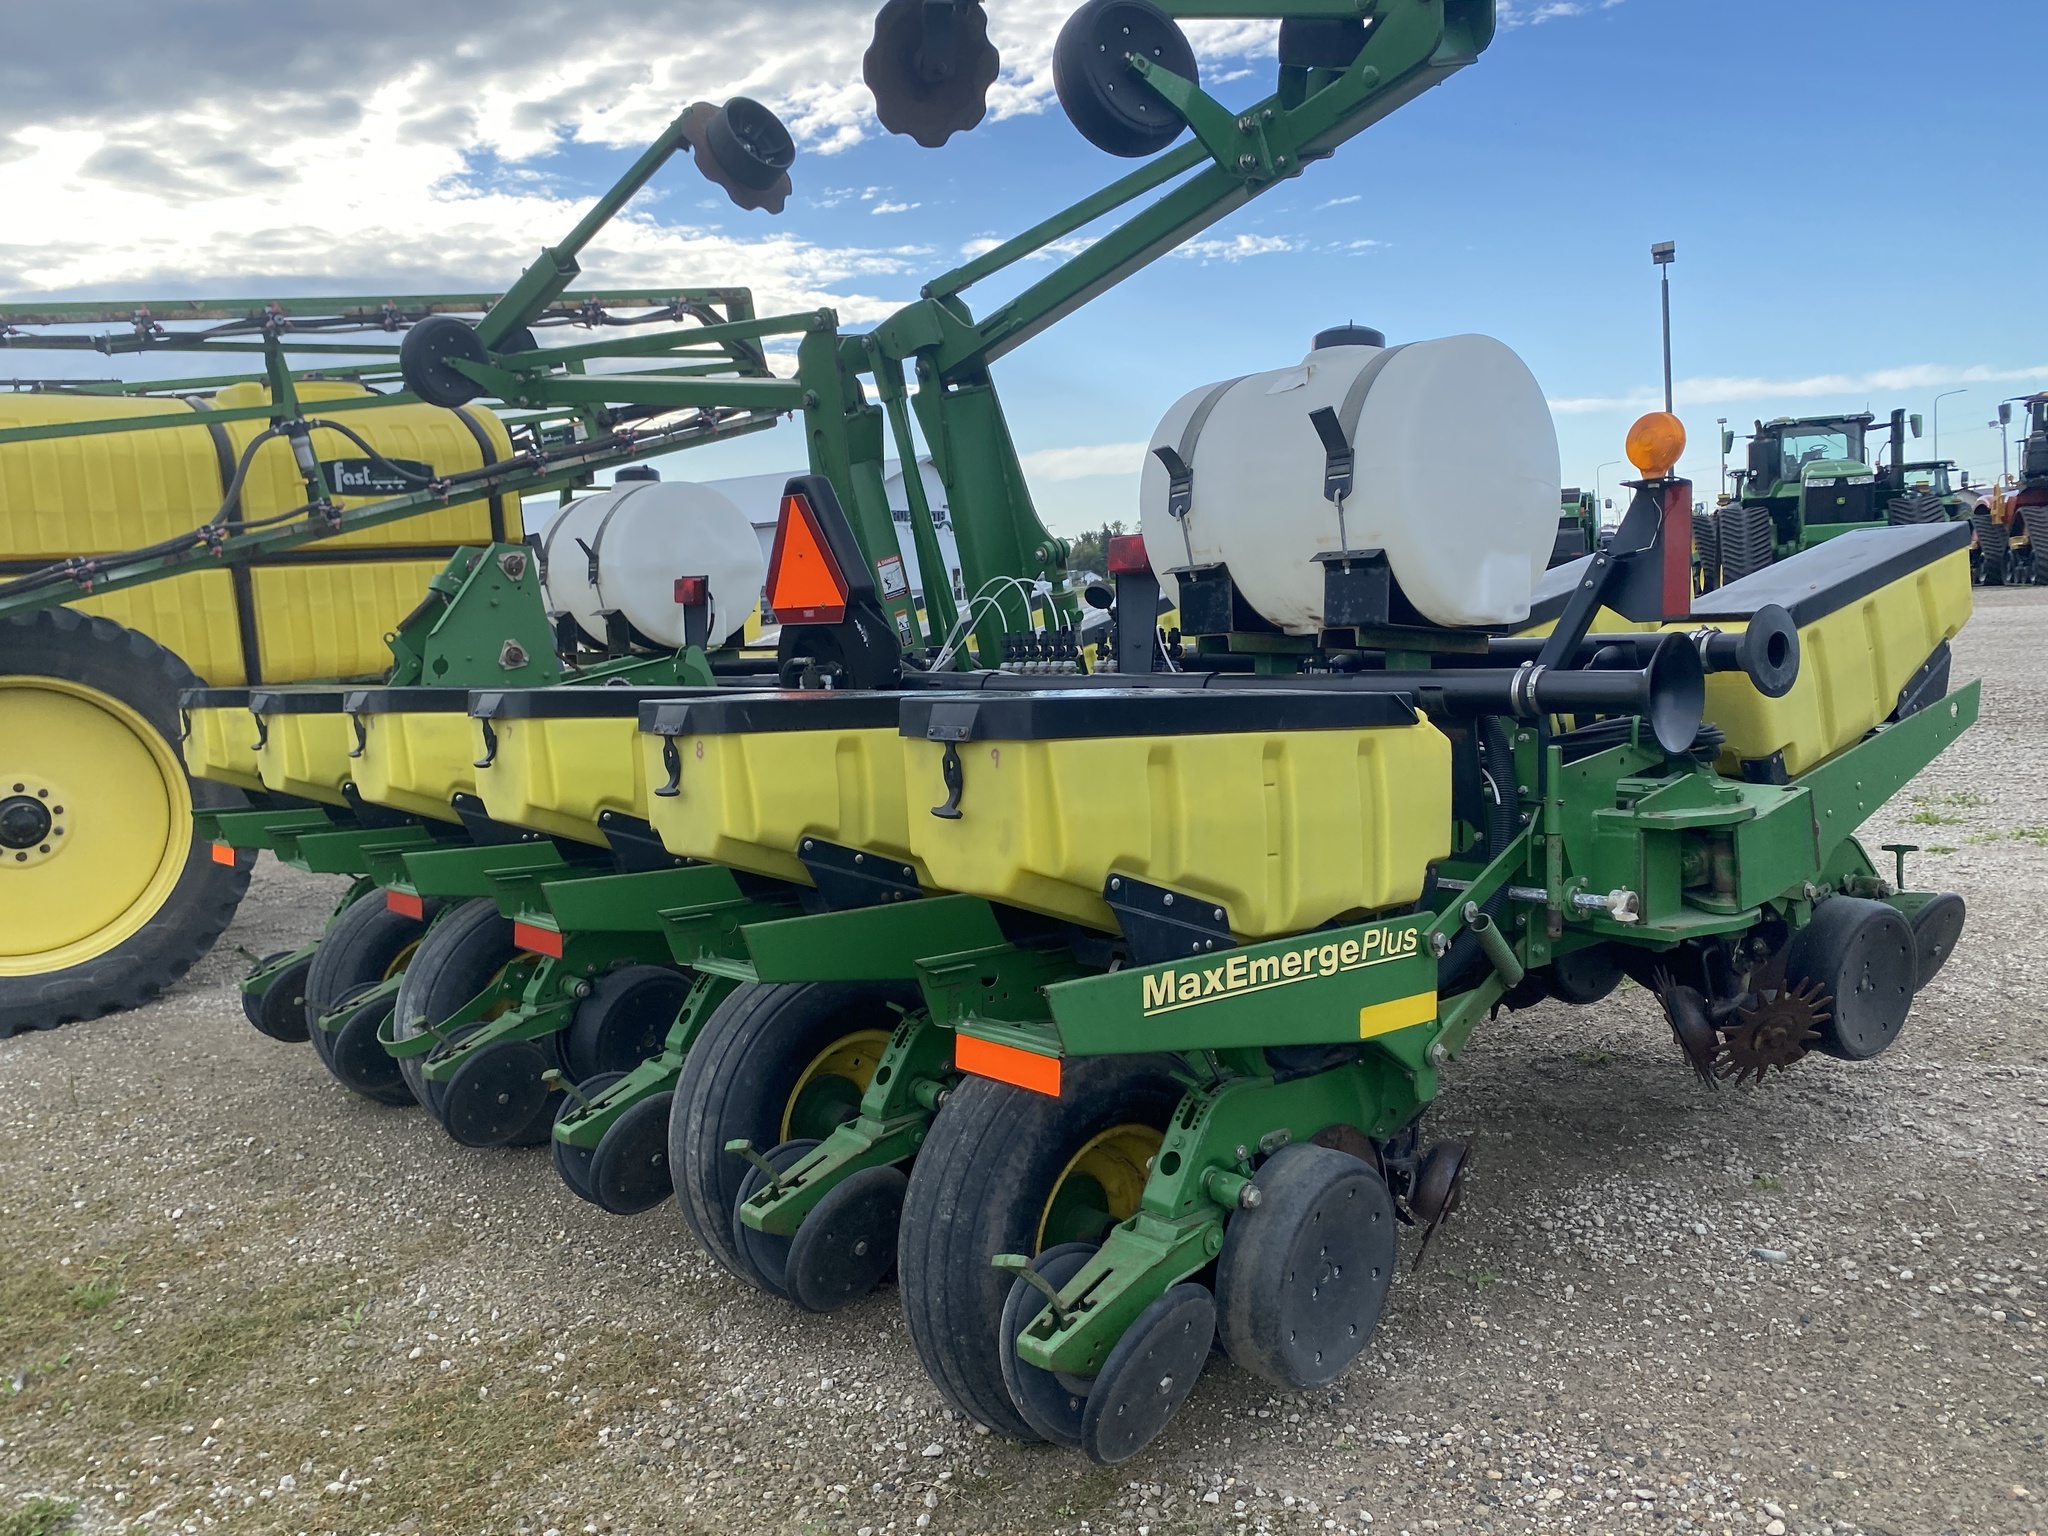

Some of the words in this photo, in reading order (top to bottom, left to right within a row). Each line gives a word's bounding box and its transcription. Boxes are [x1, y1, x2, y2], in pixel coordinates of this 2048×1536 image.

[334, 462, 371, 493] fast
[696, 740, 704, 760] 8
[990, 748, 1000, 769] 9
[1143, 926, 1418, 1010] MaxEmergePlus
